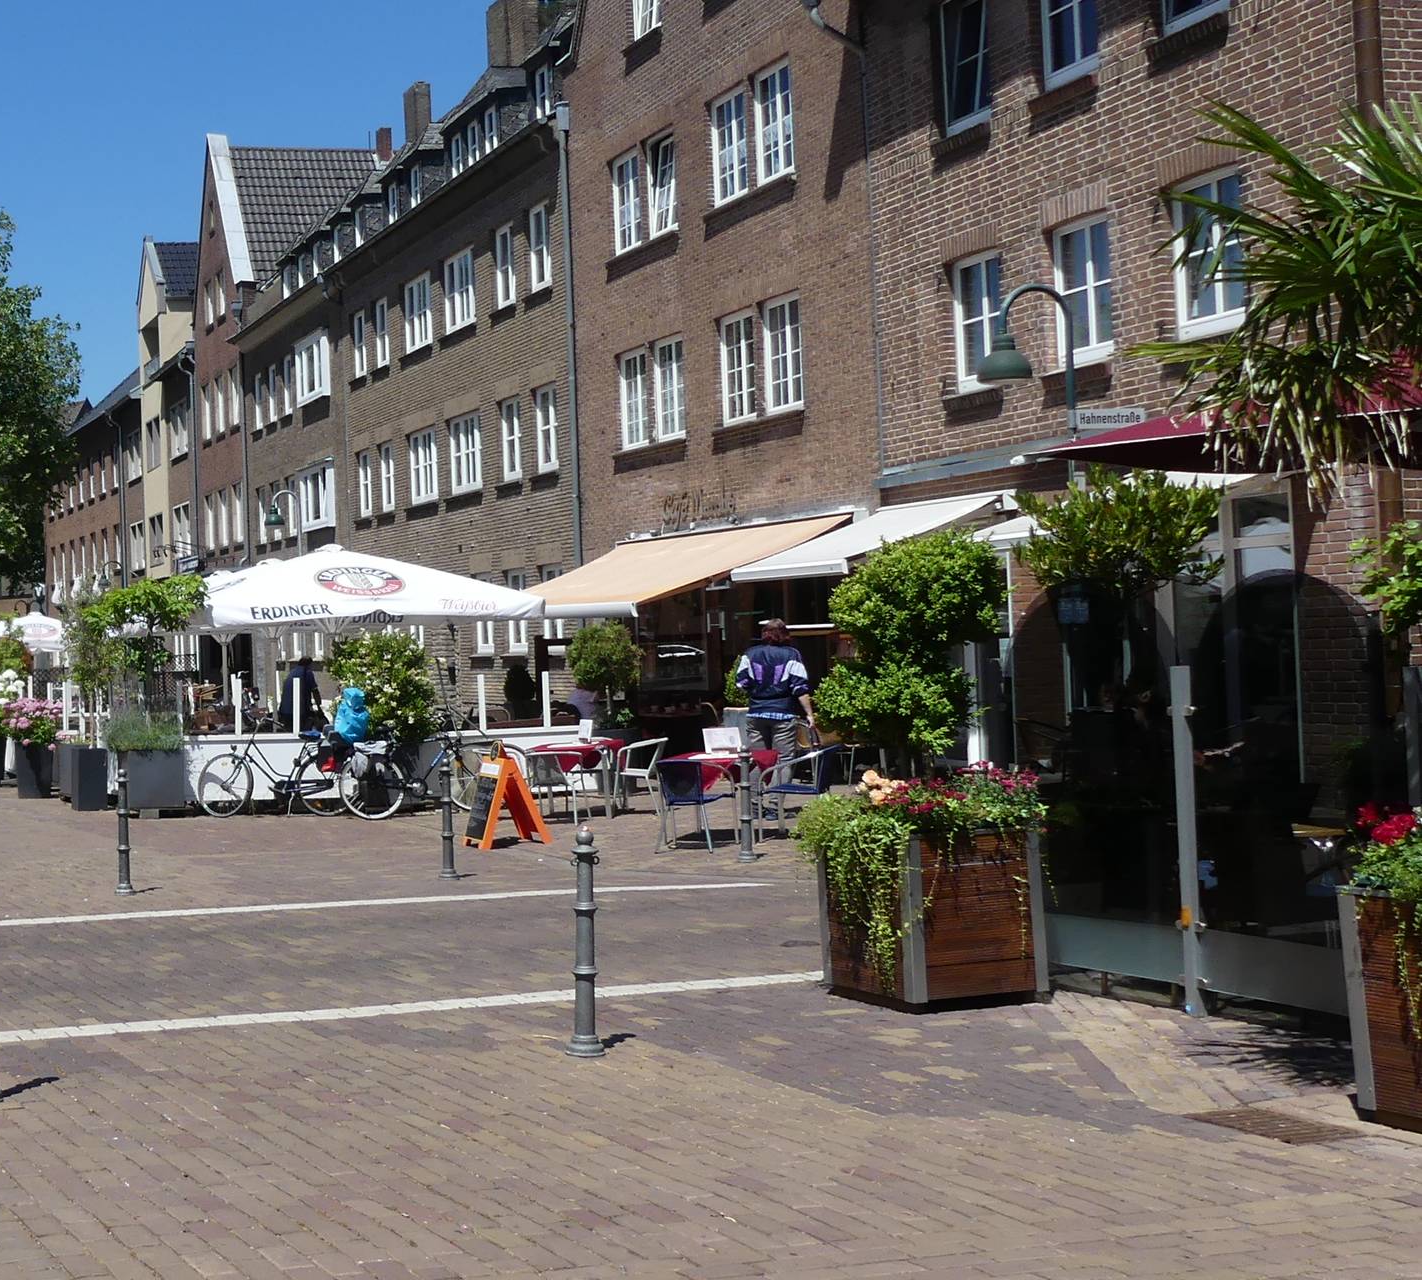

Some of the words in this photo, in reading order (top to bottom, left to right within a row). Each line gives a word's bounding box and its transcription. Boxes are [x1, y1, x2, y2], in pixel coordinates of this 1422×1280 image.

[1079, 411, 1141, 425] Hahnenstraße
[318, 567, 392, 581] ERDINGER
[250, 603, 333, 621] ERDINGER
